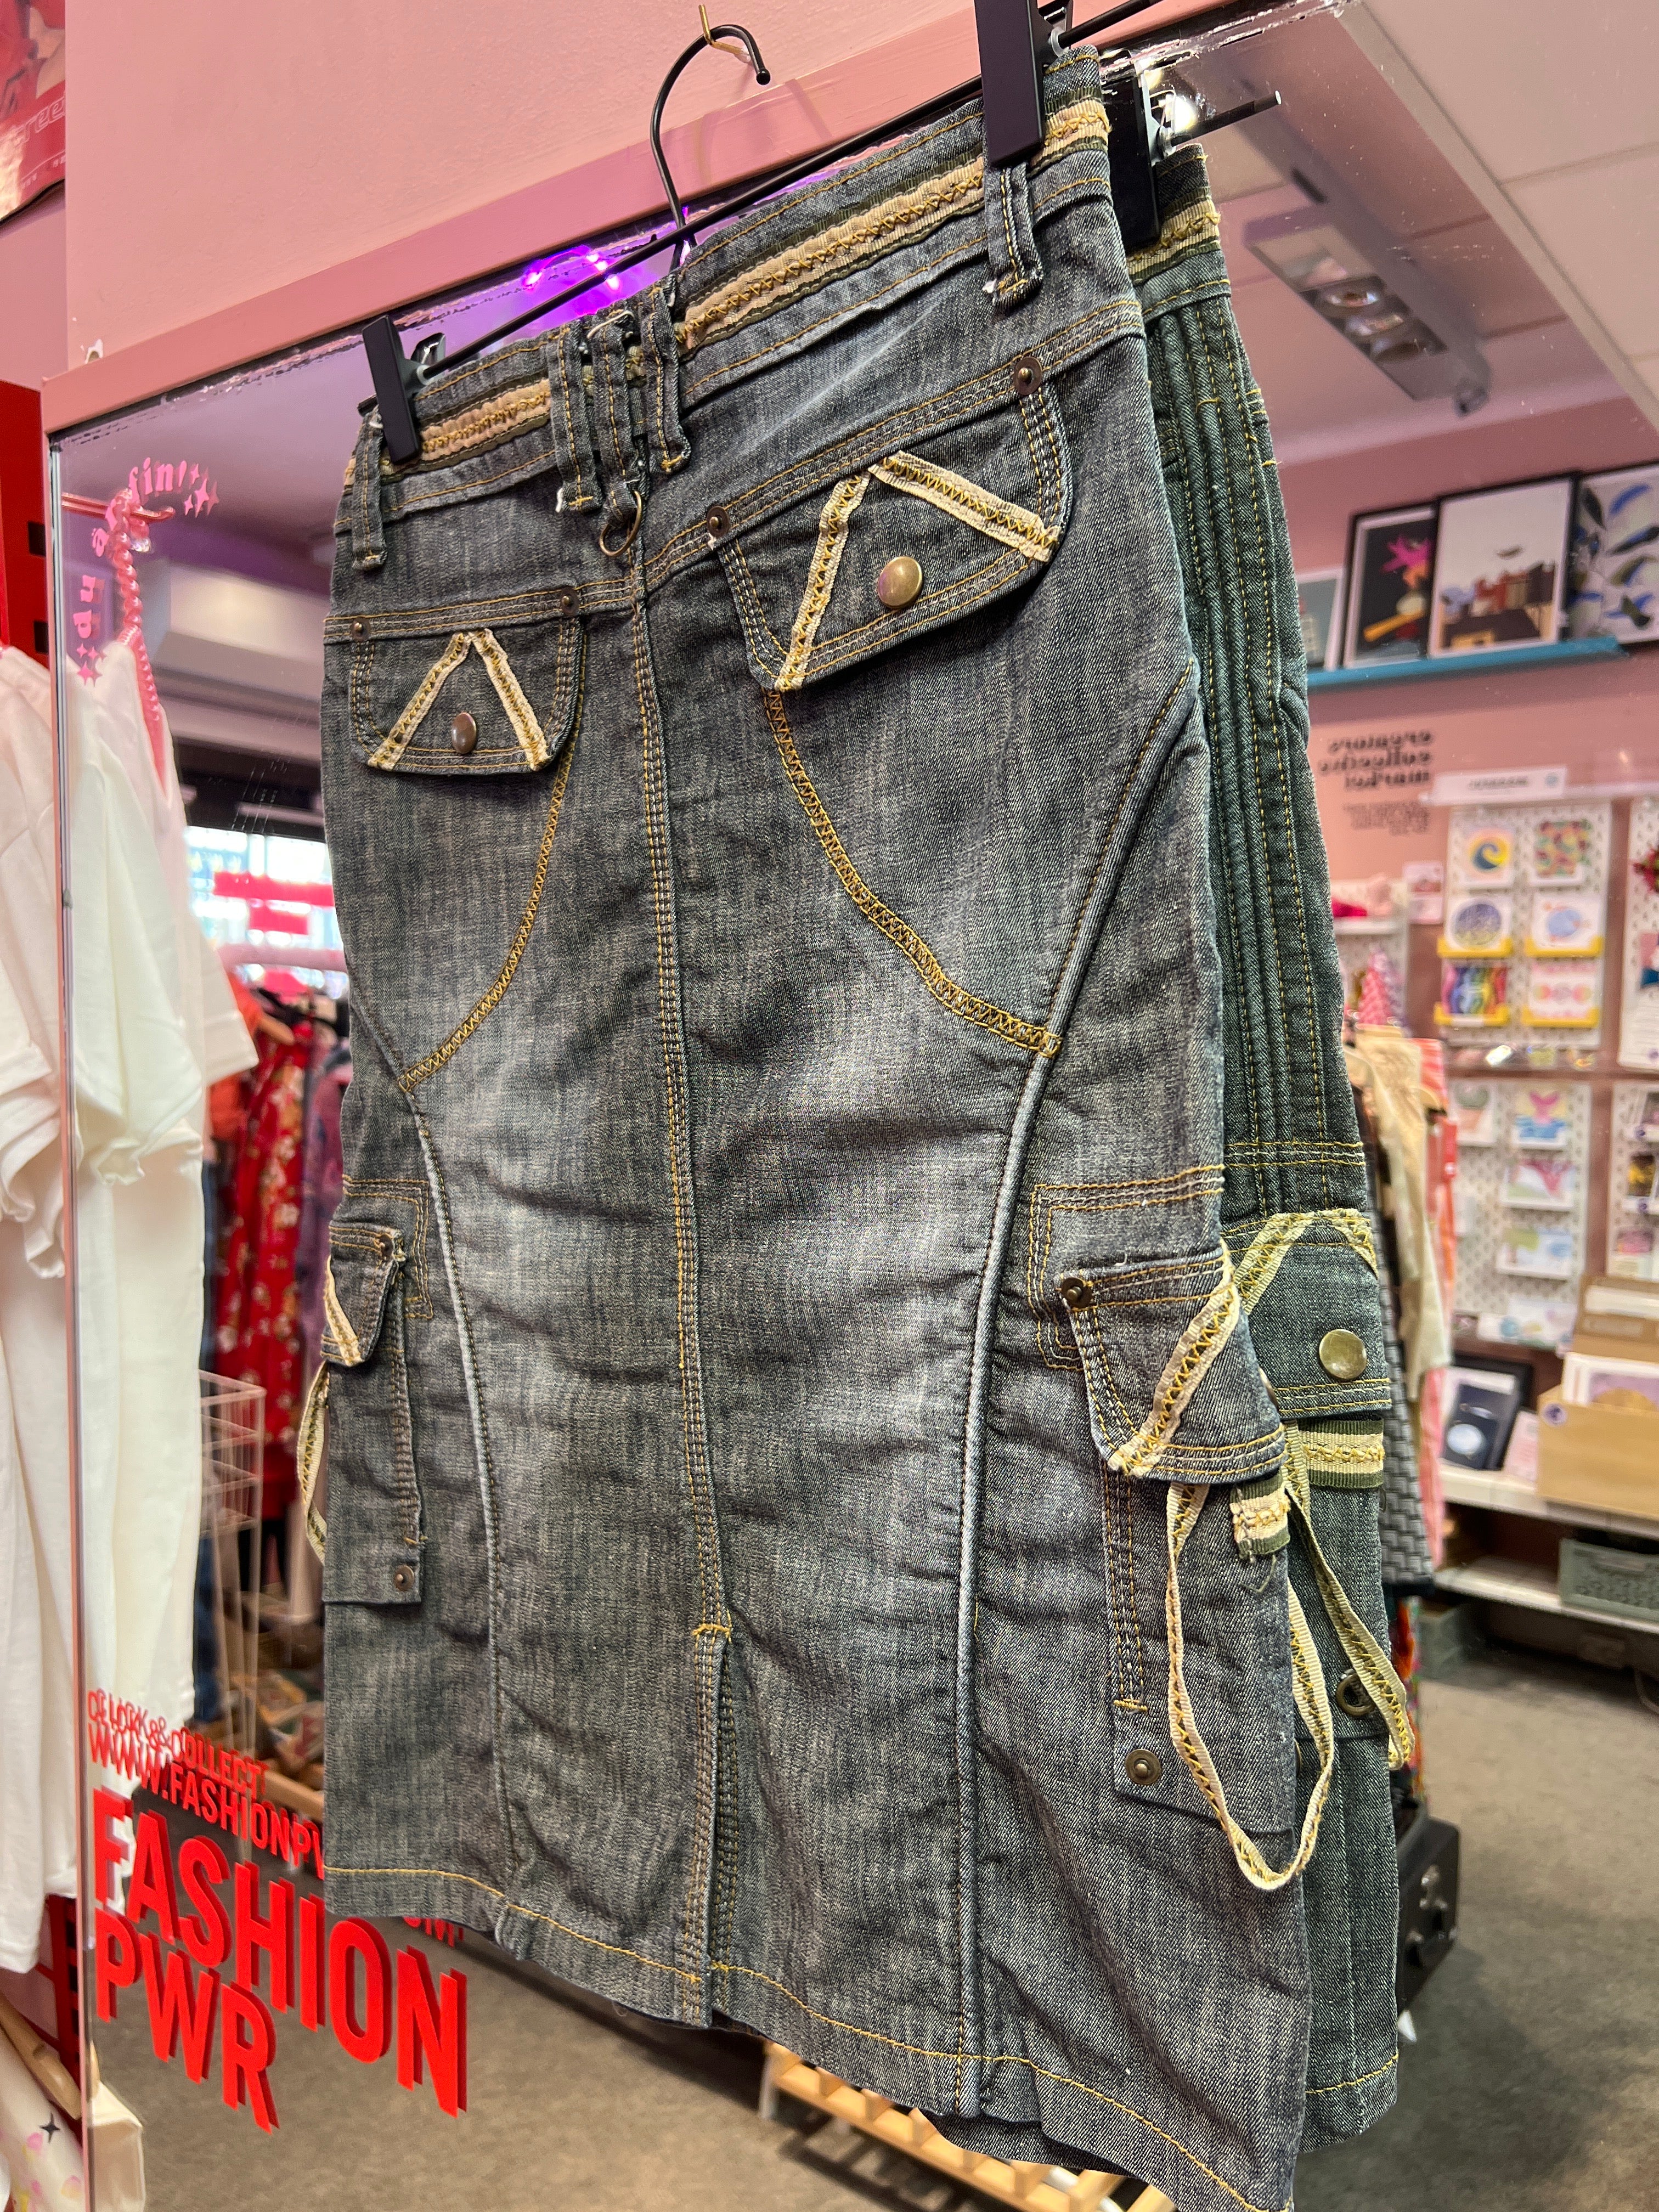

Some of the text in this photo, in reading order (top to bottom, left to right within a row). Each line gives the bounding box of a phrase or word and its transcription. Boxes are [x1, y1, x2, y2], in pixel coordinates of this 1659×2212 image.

[88, 1723, 325, 1880] WWW.FASHIONP
[171, 1729, 262, 1801] COLLECT
[93, 1791, 459, 2119] FASHION
[94, 1908, 273, 2135] PWR
